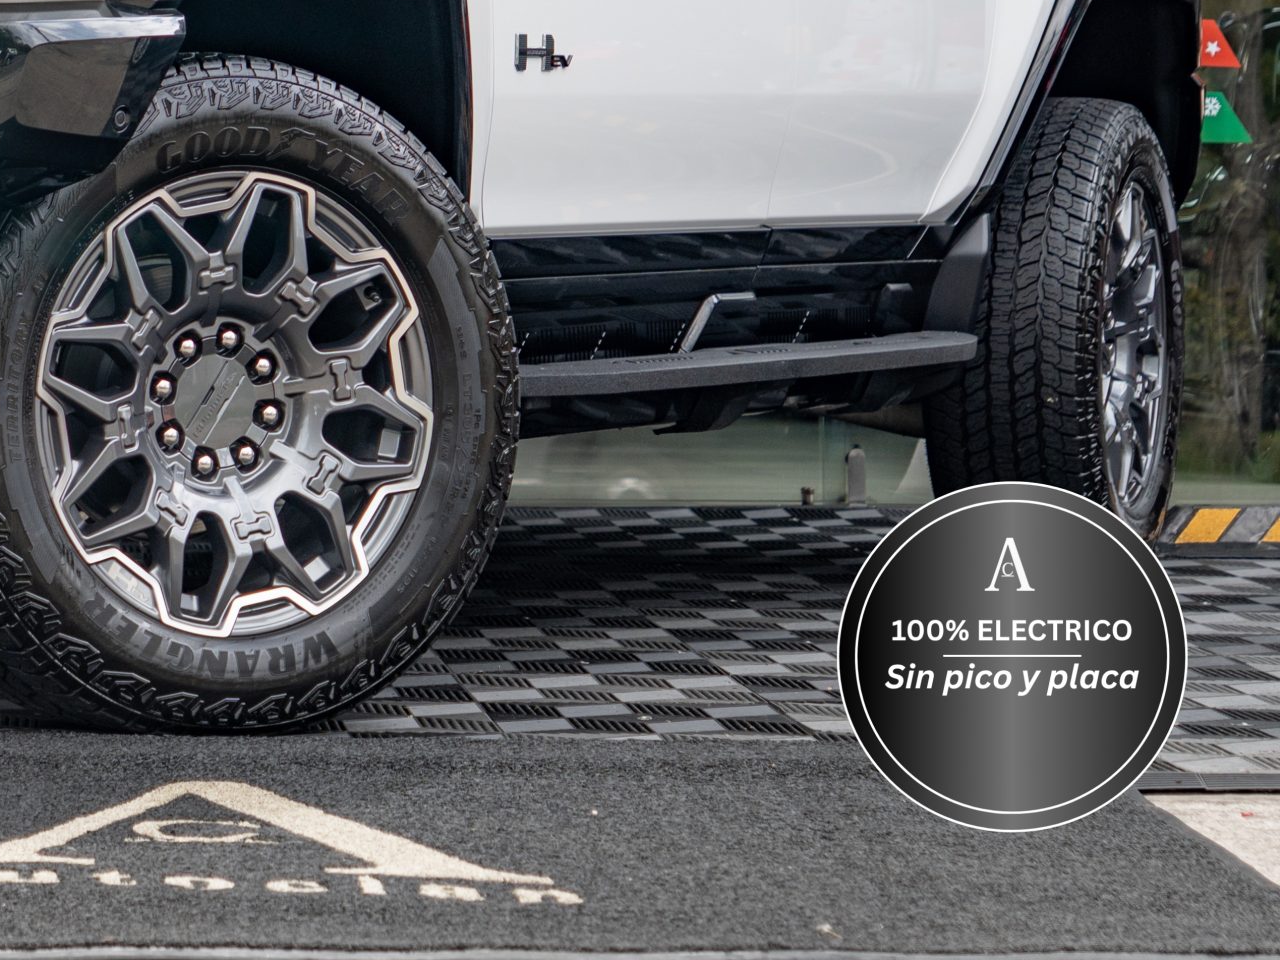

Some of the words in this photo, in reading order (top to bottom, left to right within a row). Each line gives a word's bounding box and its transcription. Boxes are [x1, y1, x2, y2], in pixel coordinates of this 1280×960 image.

[550, 54, 573, 69] EV
[155, 125, 409, 228] GOODYEAR
[83, 595, 342, 680] WRANGLER
